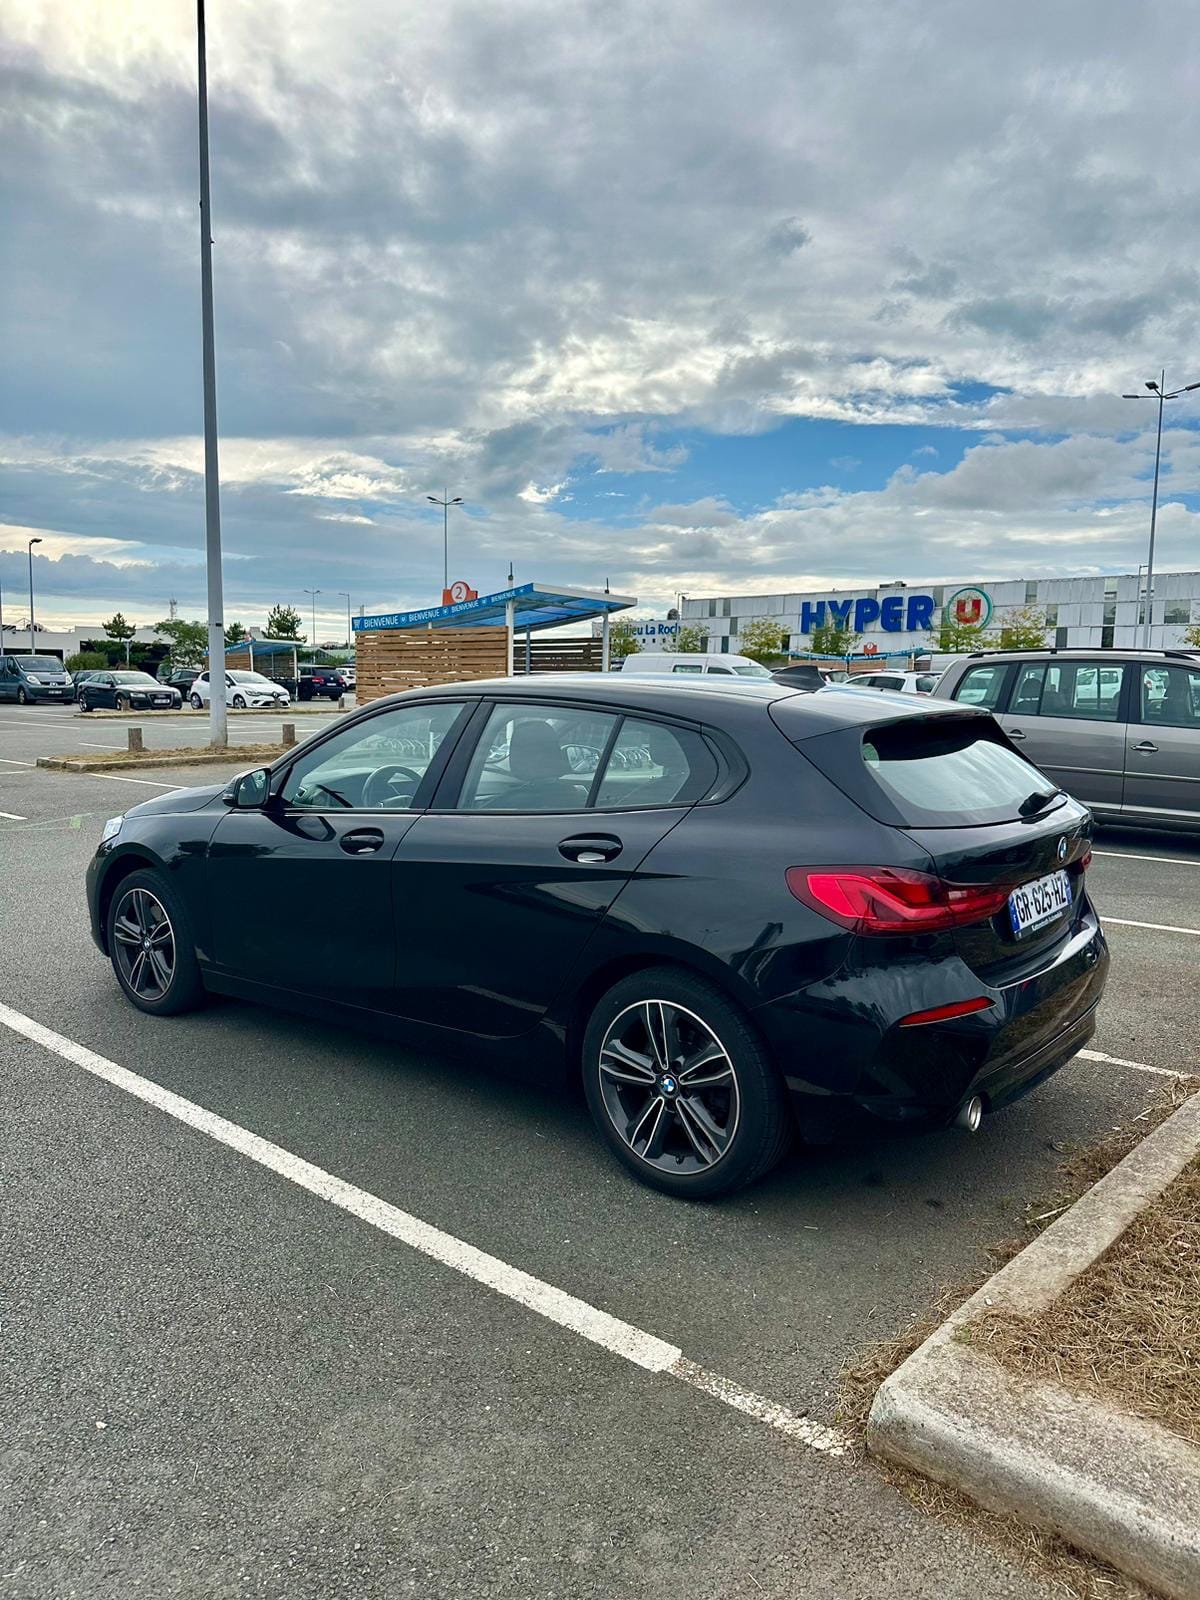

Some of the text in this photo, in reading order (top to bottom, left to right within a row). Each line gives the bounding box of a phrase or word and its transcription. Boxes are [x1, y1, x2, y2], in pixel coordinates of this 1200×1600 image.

[455, 586, 464, 600] 2
[364, 590, 516, 628] BIENVENUE BIENVENUE BIENVENUE BIENVENUE
[801, 595, 935, 633] HYPER
[957, 598, 981, 623] U
[645, 623, 656, 635] La
[1015, 876, 1067, 923] GR-625-HZ
